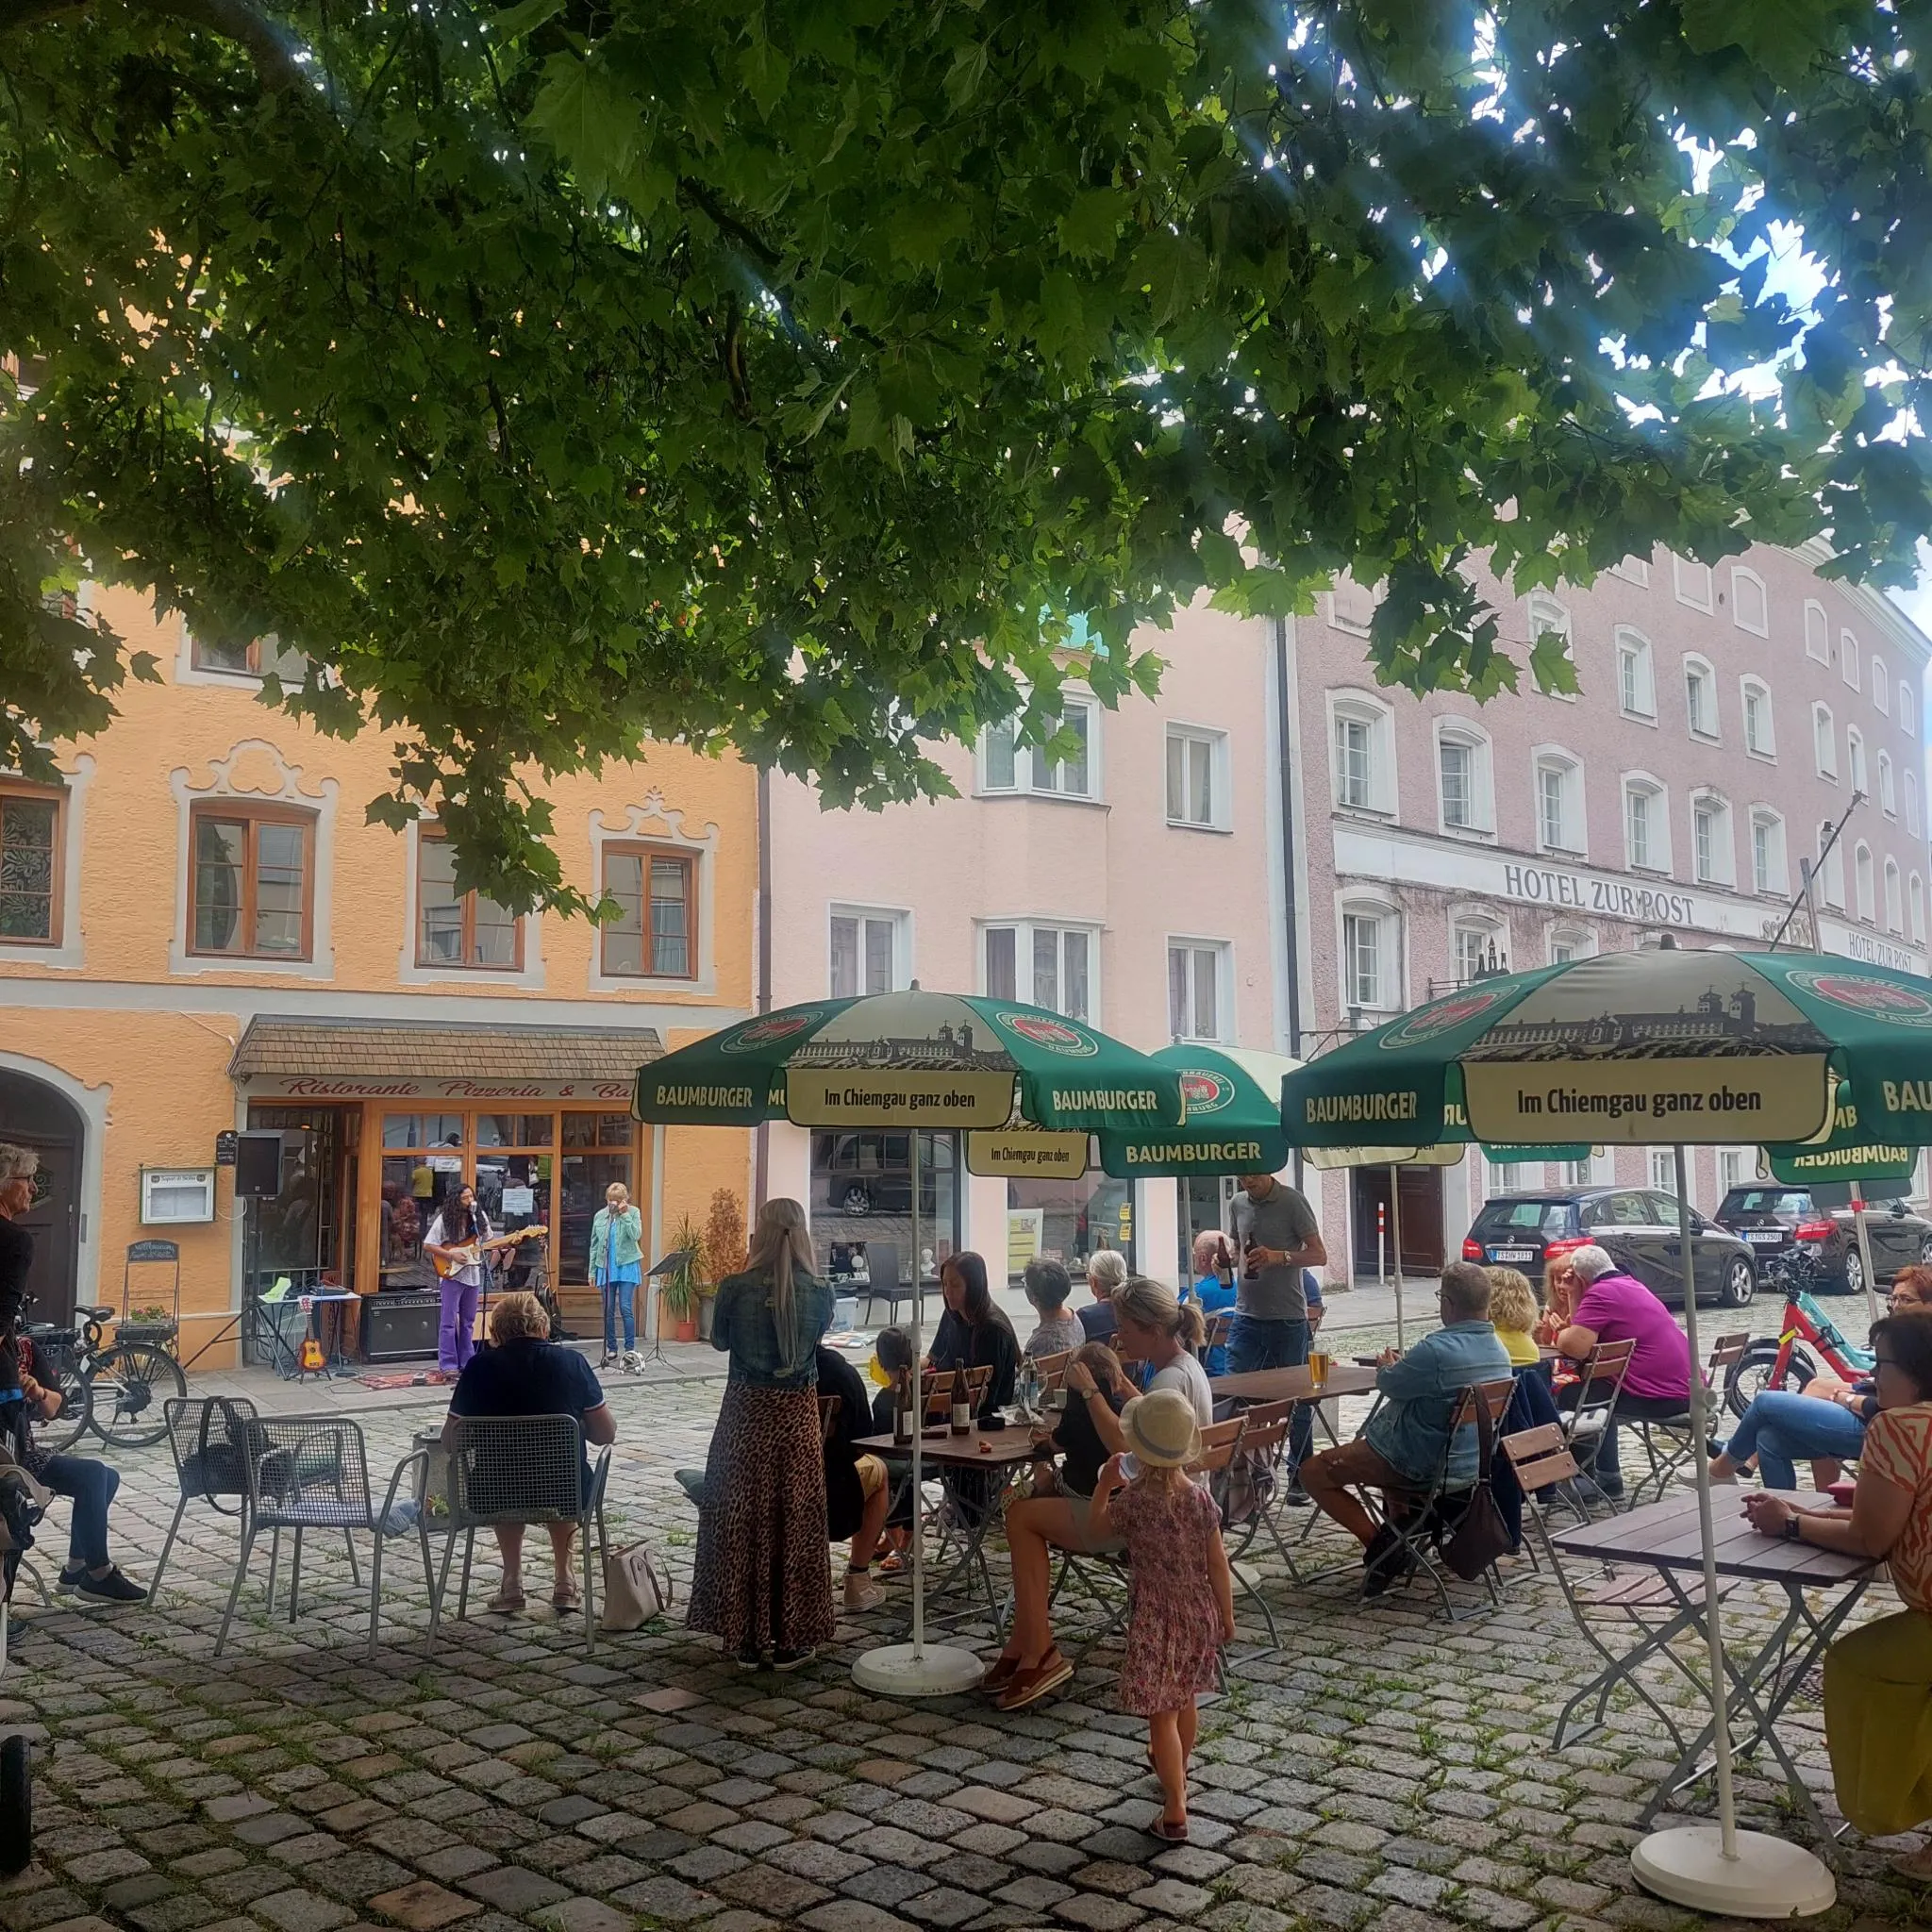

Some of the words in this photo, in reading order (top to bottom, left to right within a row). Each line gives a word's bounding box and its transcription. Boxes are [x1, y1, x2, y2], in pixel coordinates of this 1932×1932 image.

[1504, 864, 1586, 908] HOTEL
[1591, 880, 1638, 917] ZUR
[1641, 890, 1694, 925] POST
[1849, 932, 1876, 964] HOTEL
[1877, 943, 1892, 968] ZUR
[1895, 951, 1912, 974] POST
[279, 1077, 421, 1096] Ristorante
[438, 1080, 546, 1098] Pizzeria
[558, 1084, 575, 1097] &
[592, 1082, 633, 1099] Ba
[656, 1085, 754, 1108] BAUMBURGER
[824, 1088, 841, 1106] Im
[843, 1088, 907, 1110] Chiemgau
[909, 1093, 941, 1110] ganz
[943, 1090, 975, 1108] oben
[1052, 1090, 1158, 1111] BAUMBURGER
[1306, 1091, 1417, 1124] BAUMBURGER
[1517, 1090, 1541, 1113] Im
[1547, 1088, 1647, 1119] Chiemgau
[1652, 1092, 1704, 1118] ganz
[1709, 1086, 1762, 1111] oben
[991, 1147, 1001, 1161] Im
[1002, 1147, 1036, 1164] Chiemgau
[1037, 1151, 1054, 1164] ganz
[1054, 1148, 1070, 1162] oben
[1125, 1141, 1262, 1163] BAUMBURGER
